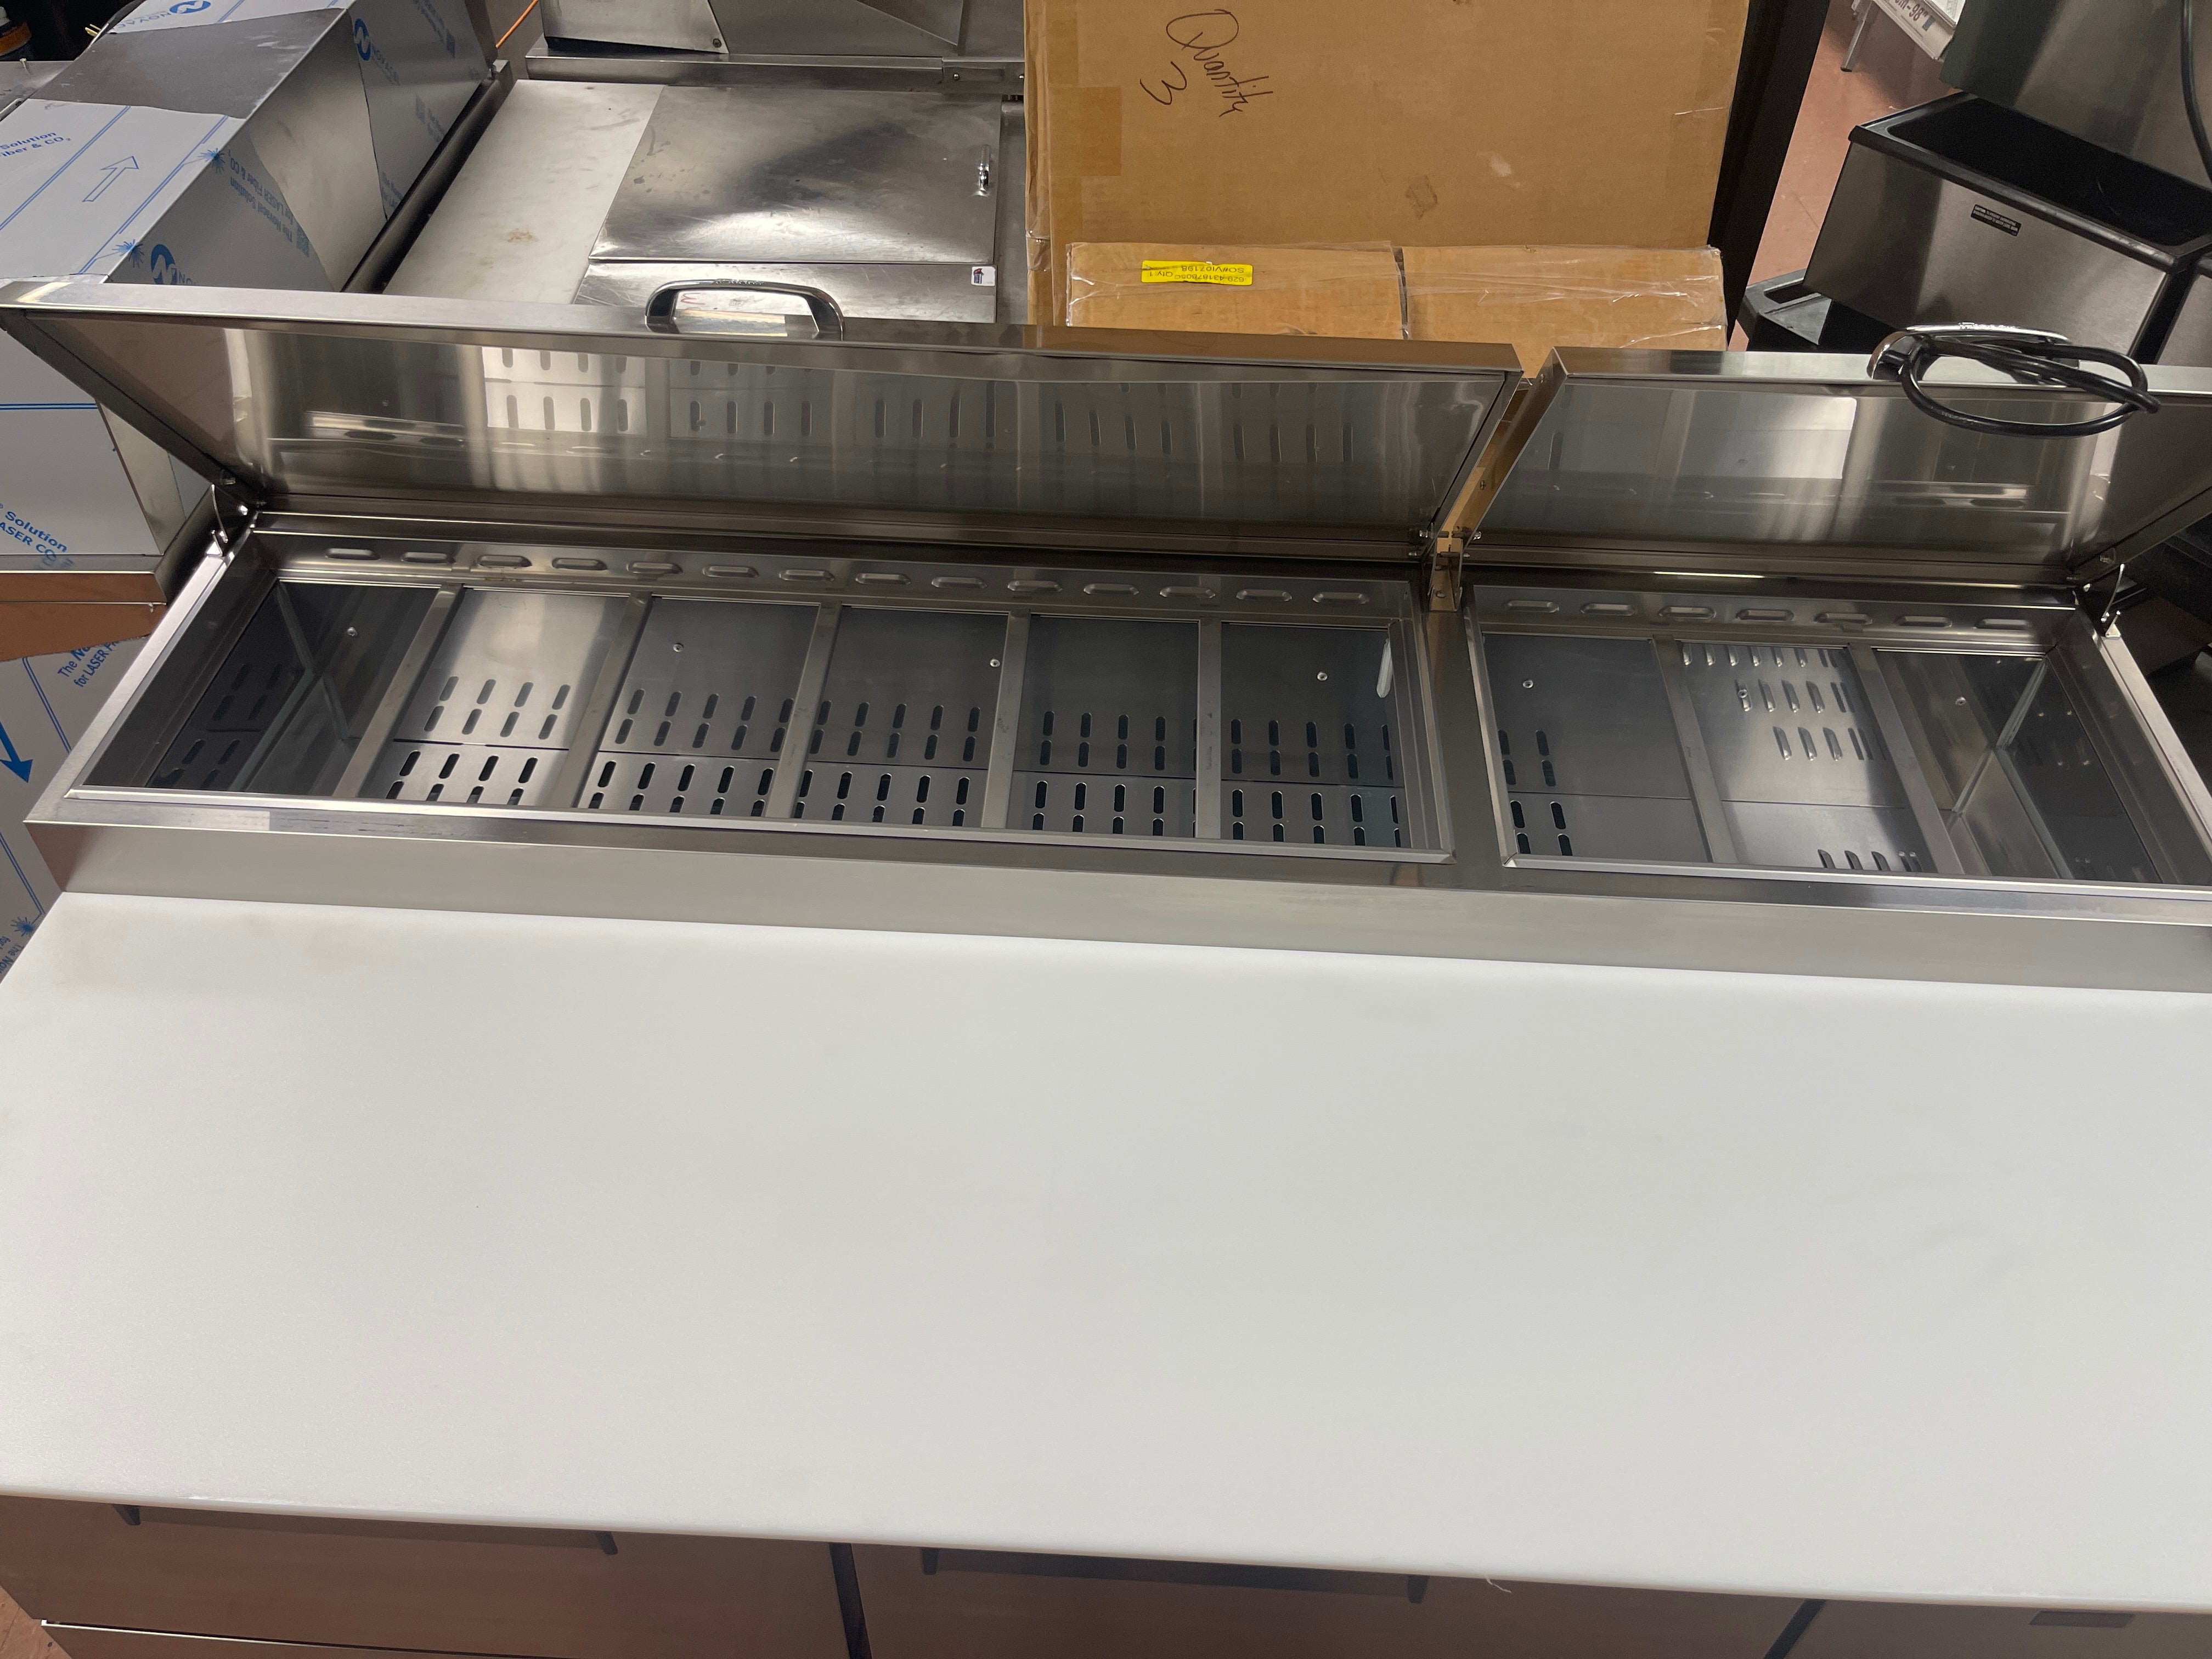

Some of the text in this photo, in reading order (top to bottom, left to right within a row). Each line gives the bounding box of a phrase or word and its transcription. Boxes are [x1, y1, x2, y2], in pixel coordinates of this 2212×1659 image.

[1166, 9, 1274, 117] Quantity
[1139, 61, 1187, 105] 3
[0, 132, 57, 149] Solution
[0, 147, 27, 157] iber
[5, 511, 67, 553] Solution
[57, 661, 77, 678] The
[74, 674, 89, 687] for
[83, 650, 110, 676] LASER
